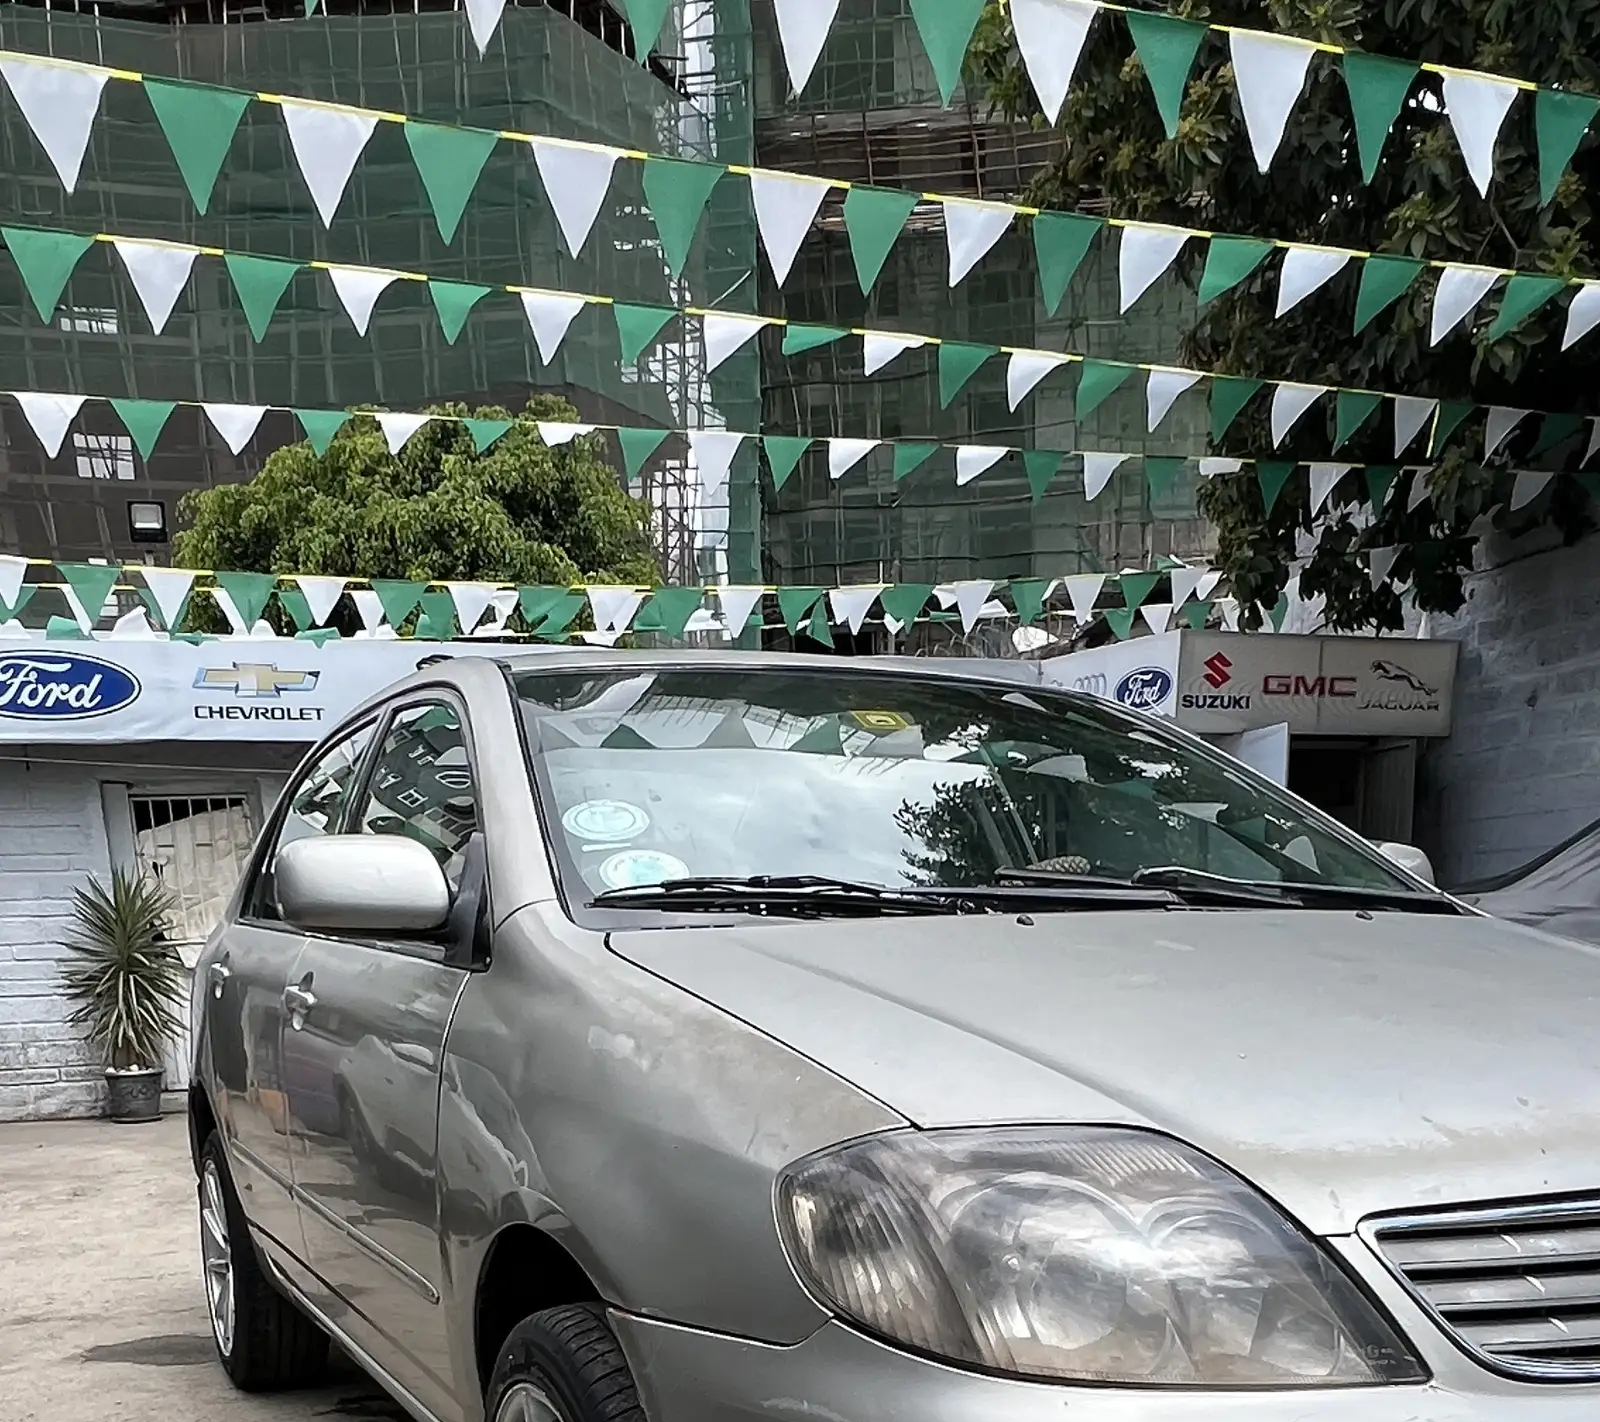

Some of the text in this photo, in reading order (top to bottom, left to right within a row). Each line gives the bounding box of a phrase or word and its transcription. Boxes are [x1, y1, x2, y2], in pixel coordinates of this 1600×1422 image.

[0, 659, 103, 708] Ford
[1123, 673, 1162, 706] Ford
[1262, 674, 1358, 698] GMC
[193, 705, 326, 721] CHEVROLET
[1181, 694, 1251, 710] SUZUKI
